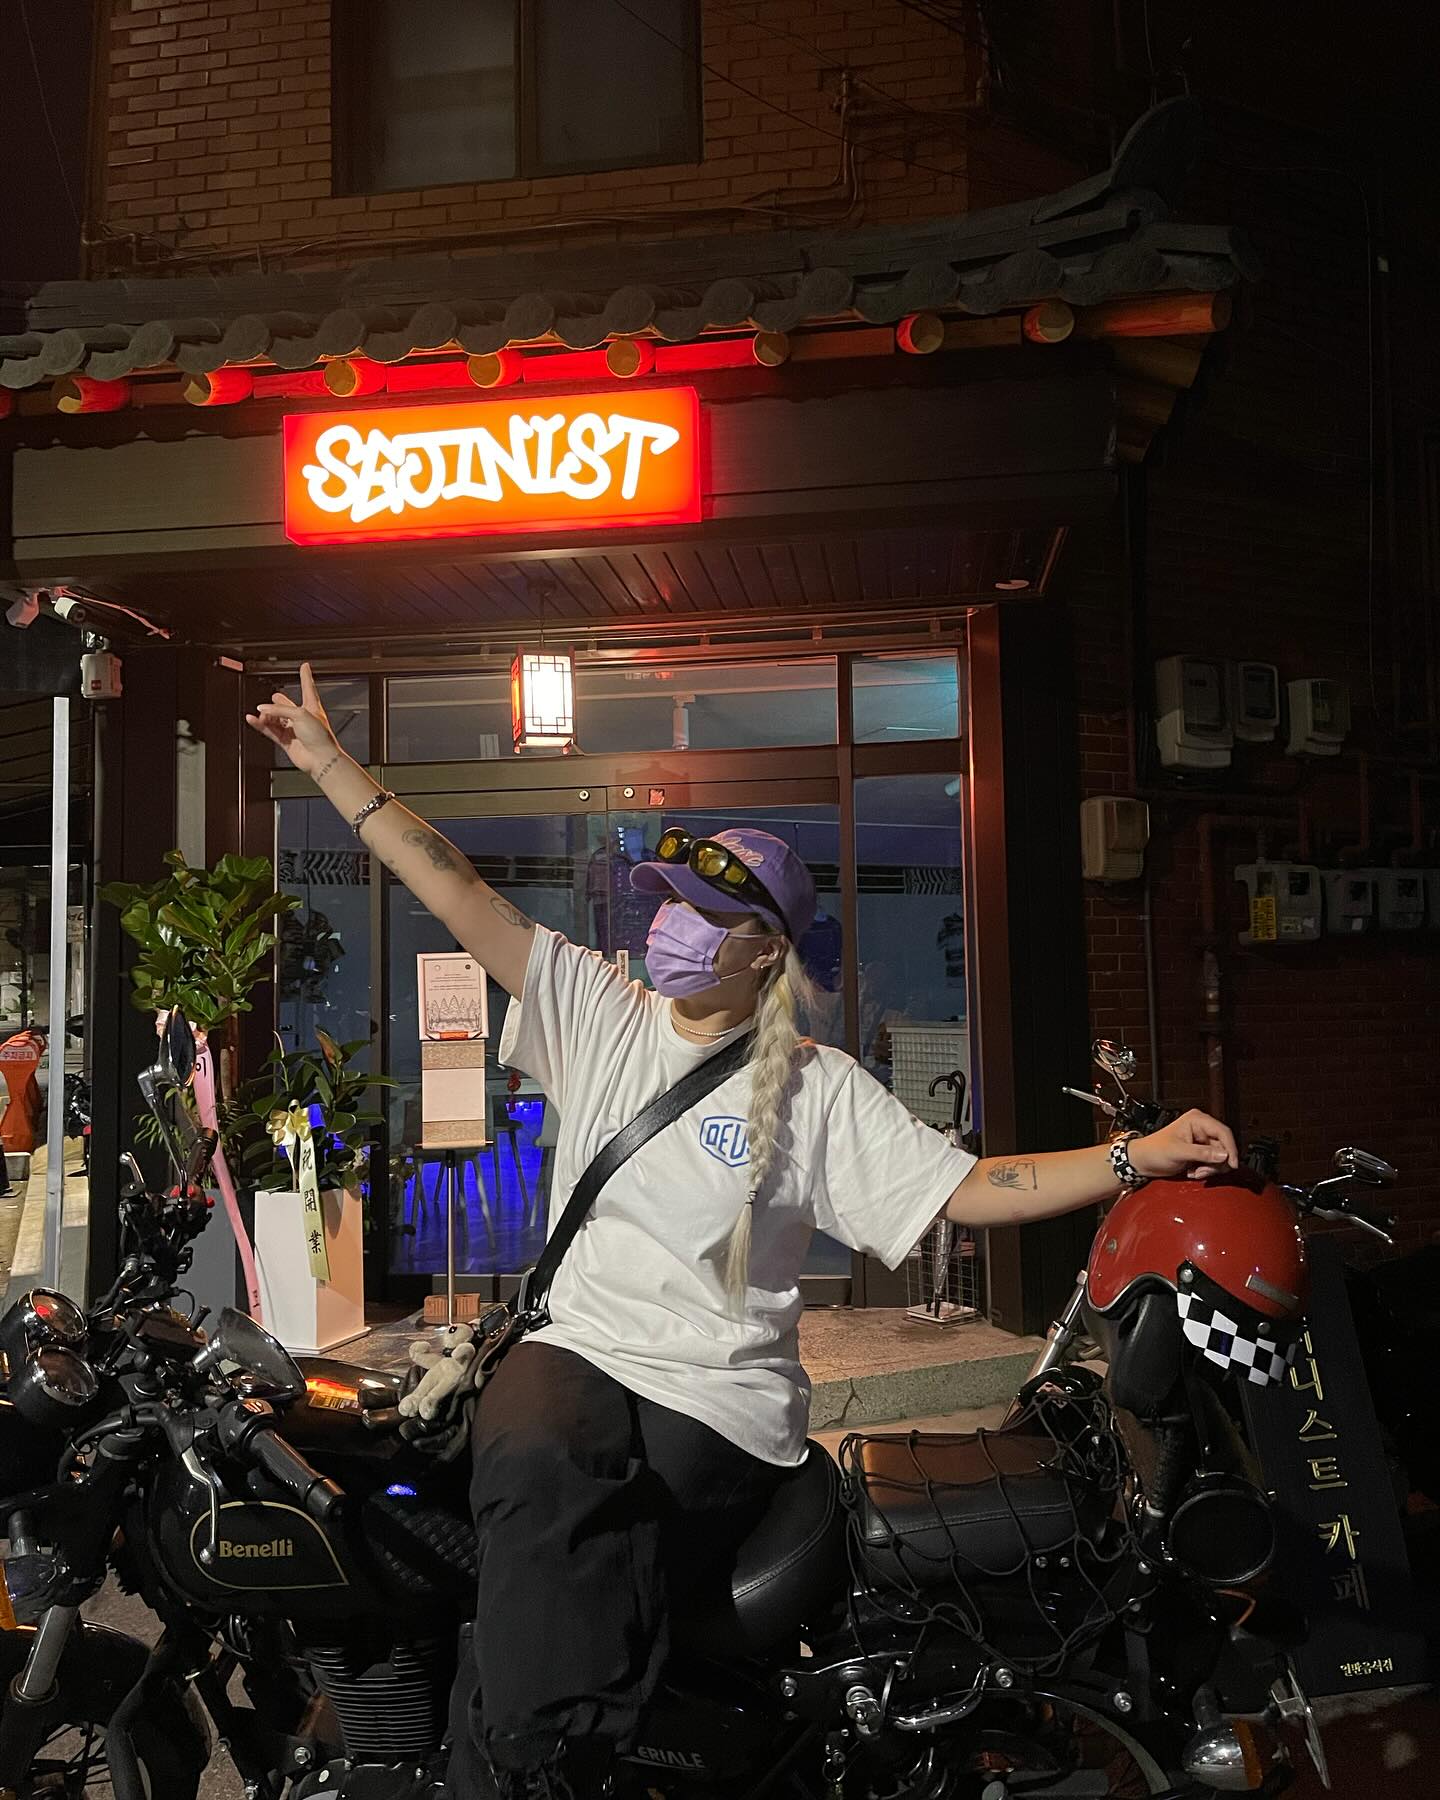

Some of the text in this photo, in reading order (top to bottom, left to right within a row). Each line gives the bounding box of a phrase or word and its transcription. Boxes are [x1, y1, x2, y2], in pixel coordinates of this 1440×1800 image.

[302, 413, 679, 523] SEJINIST
[705, 1123, 750, 1160] DEU
[219, 1539, 294, 1558] Benelli
